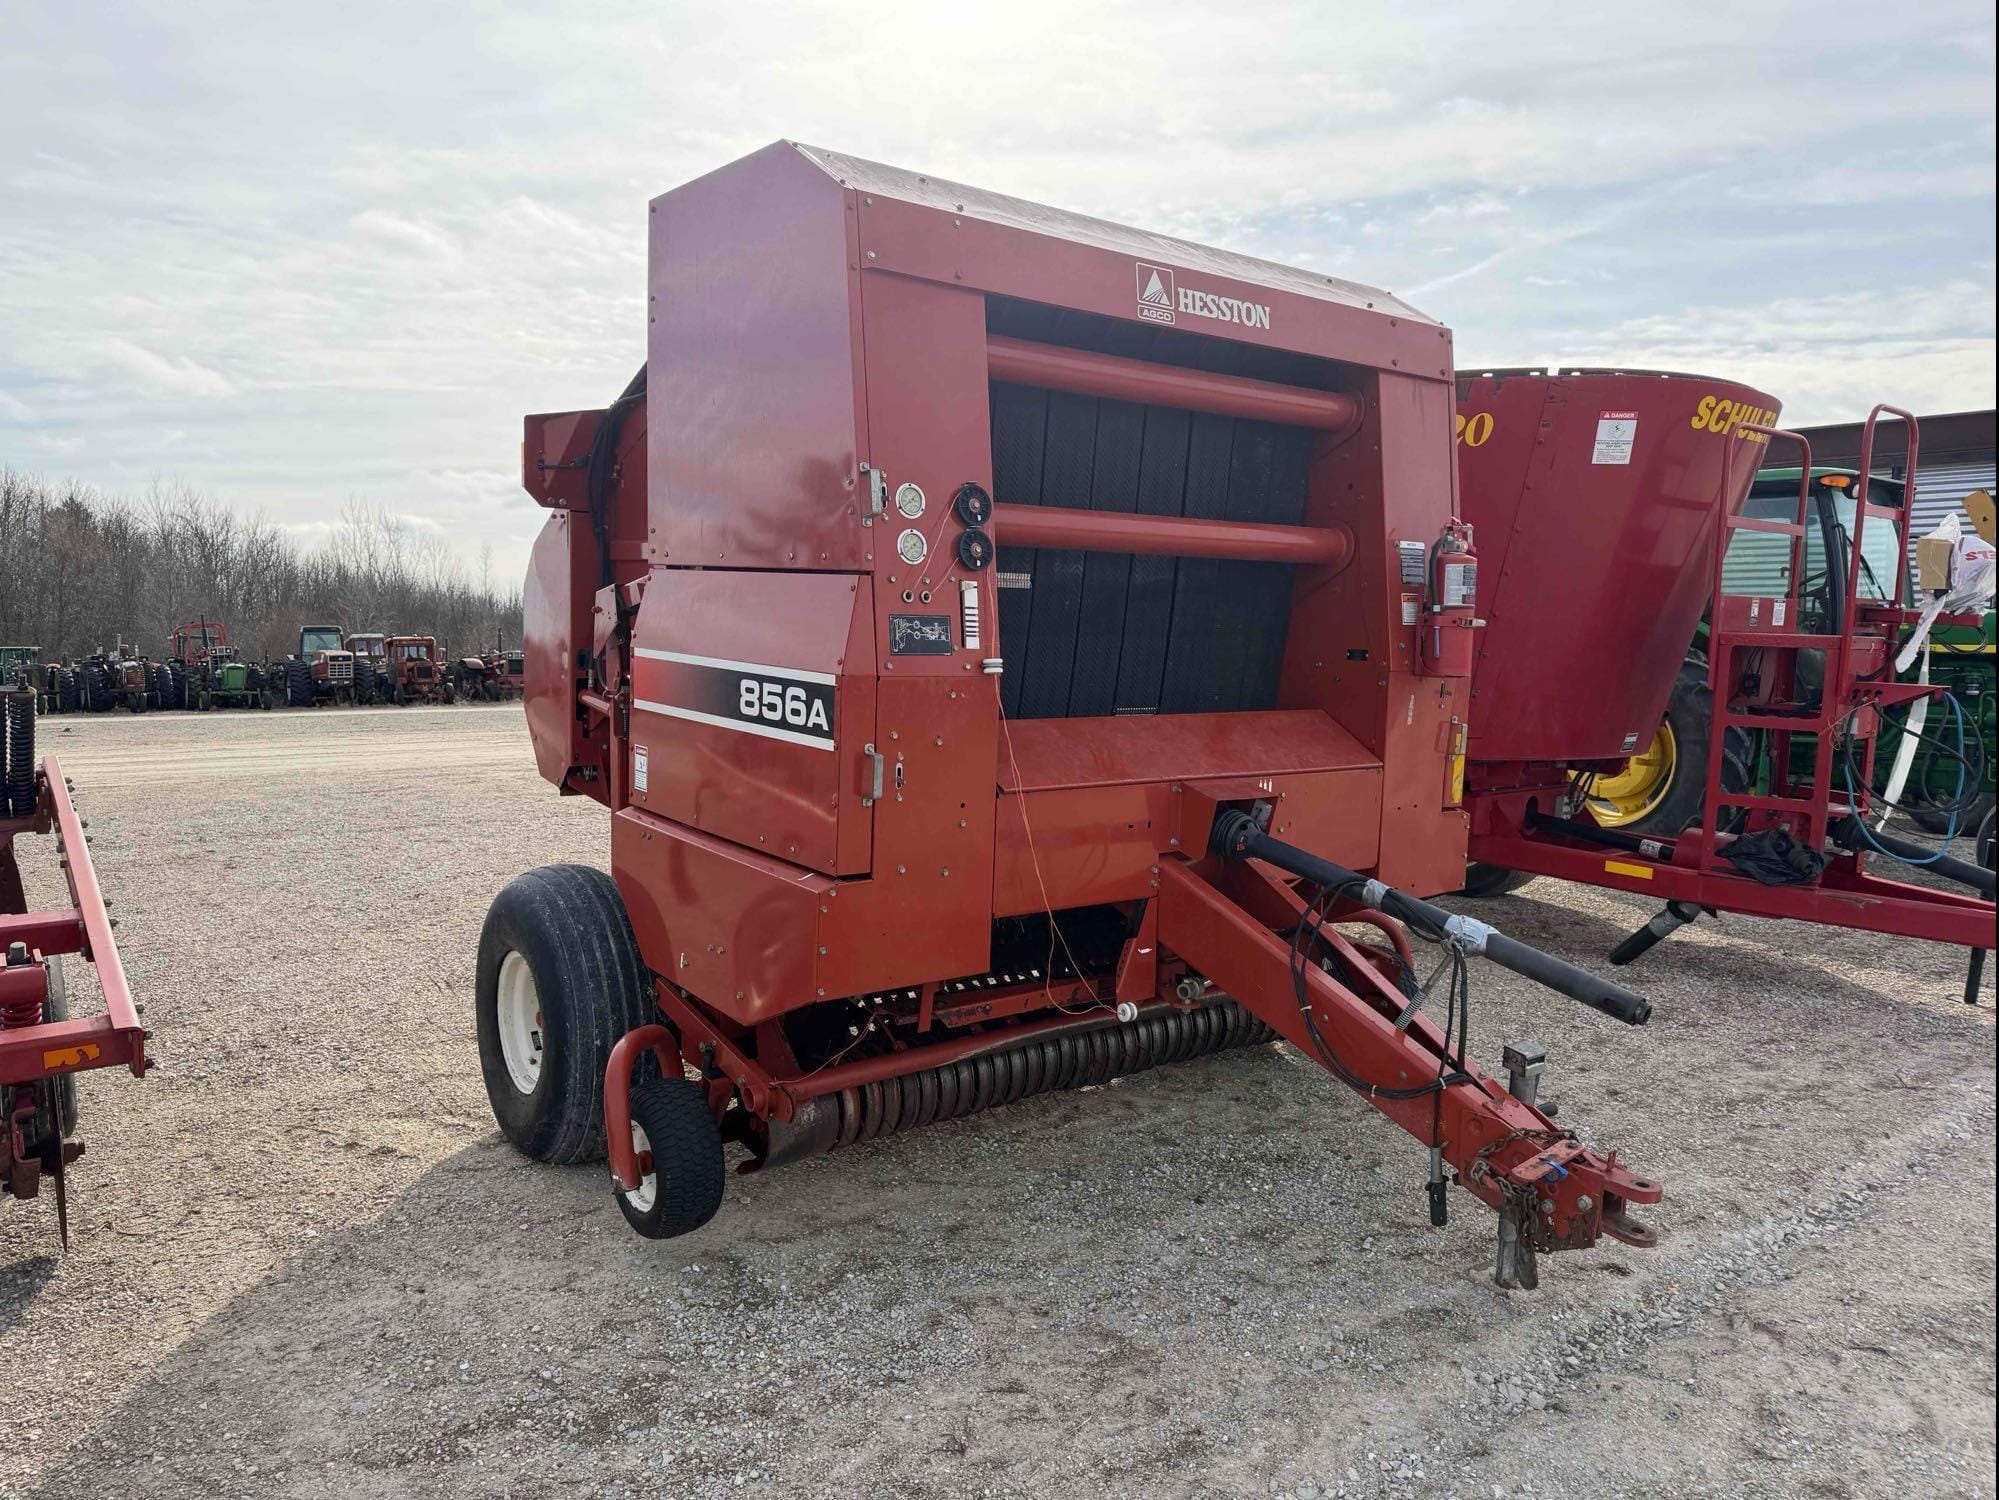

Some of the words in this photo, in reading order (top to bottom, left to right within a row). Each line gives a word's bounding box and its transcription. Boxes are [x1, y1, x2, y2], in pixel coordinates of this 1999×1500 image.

[1142, 310, 1171, 321] AGCO
[1177, 287, 1271, 330] HESSTON
[739, 678, 830, 731] 856A
